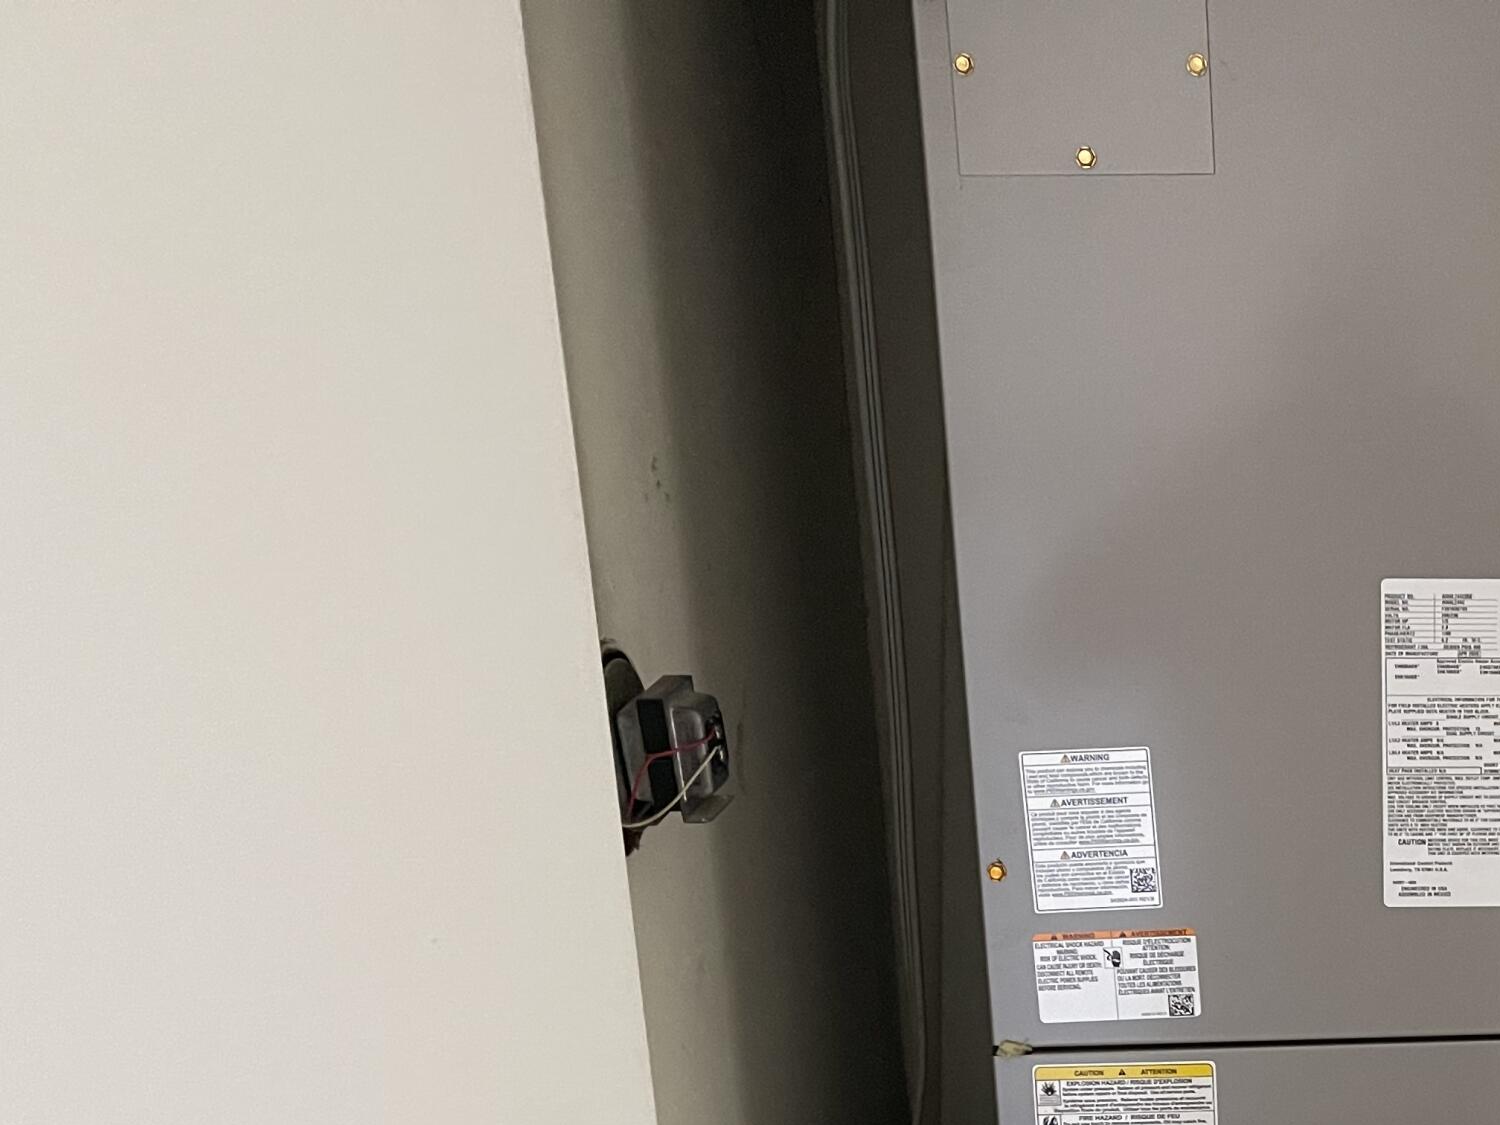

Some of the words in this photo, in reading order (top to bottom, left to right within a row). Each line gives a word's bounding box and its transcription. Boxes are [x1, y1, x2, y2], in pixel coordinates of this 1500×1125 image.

[1070, 754, 1110, 762] WARNING
[1061, 796, 1128, 807] AVERTISSEMENT
[1071, 850, 1128, 859] ADVERTENCIA
